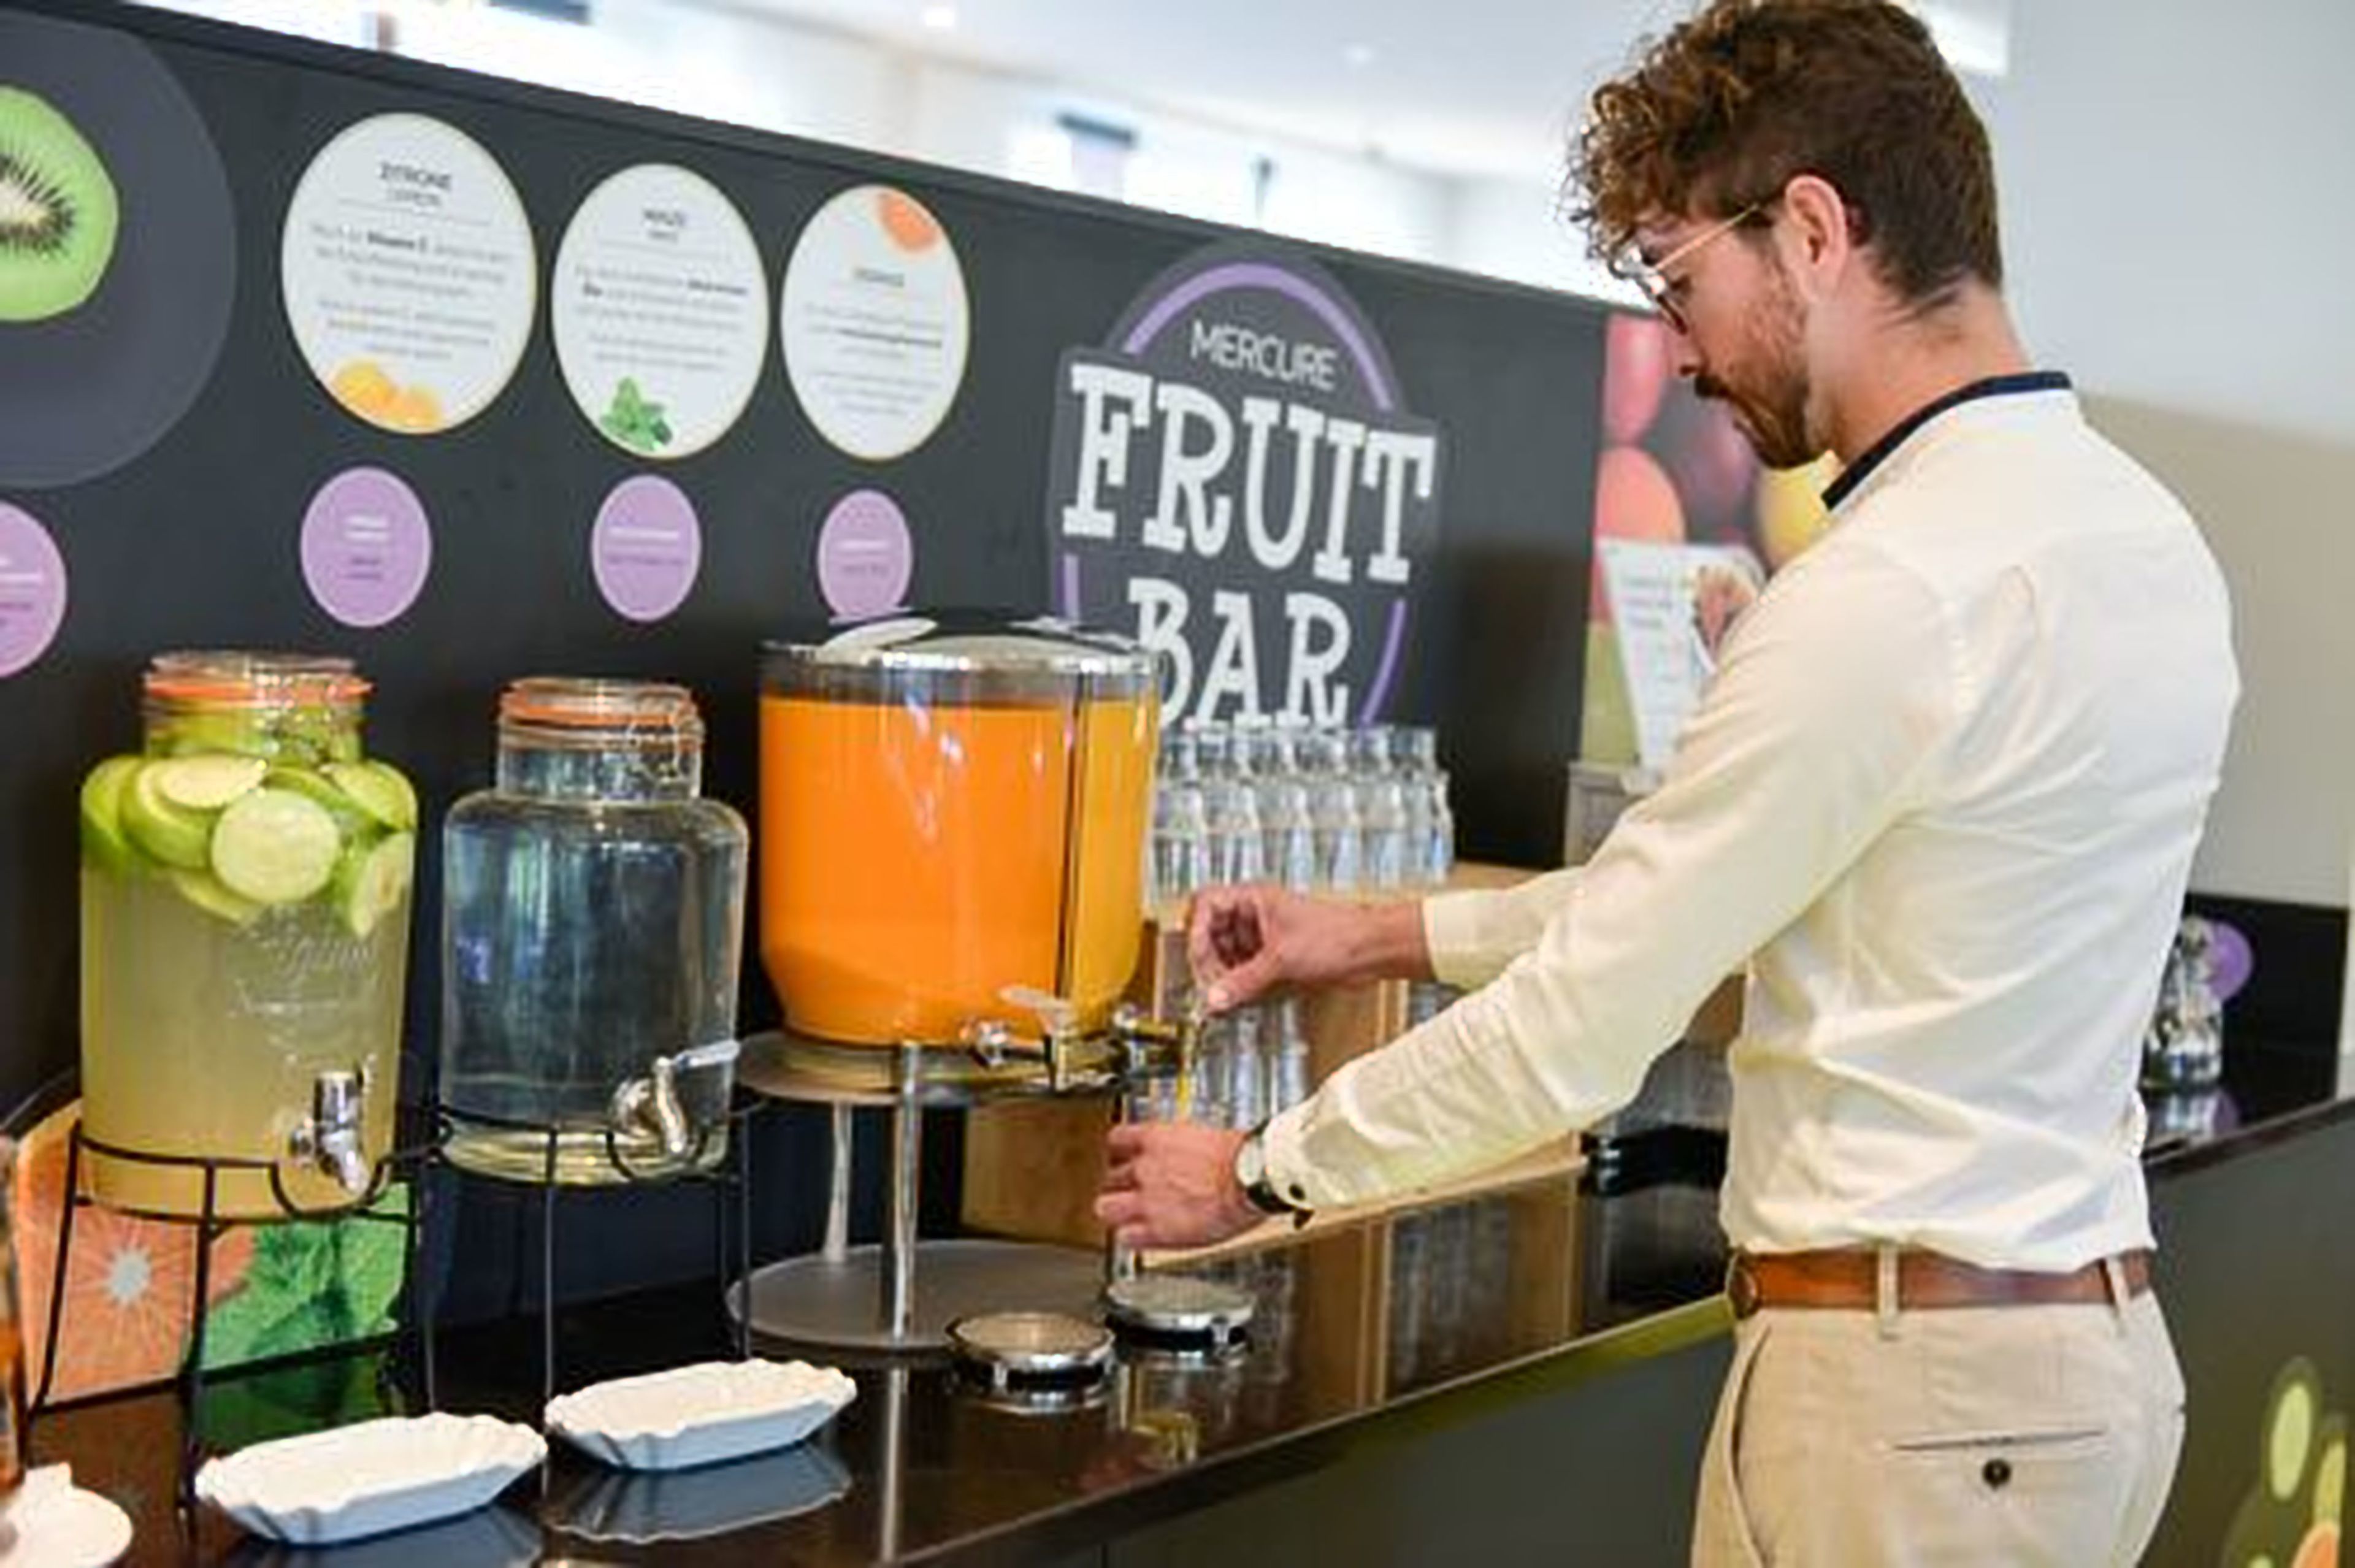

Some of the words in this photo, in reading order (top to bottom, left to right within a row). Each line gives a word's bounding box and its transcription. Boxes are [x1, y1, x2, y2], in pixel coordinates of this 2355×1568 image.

[1190, 318, 1339, 391] MERCURE
[1062, 362, 1436, 584] FRUIT
[1128, 577, 1351, 729] BAR
